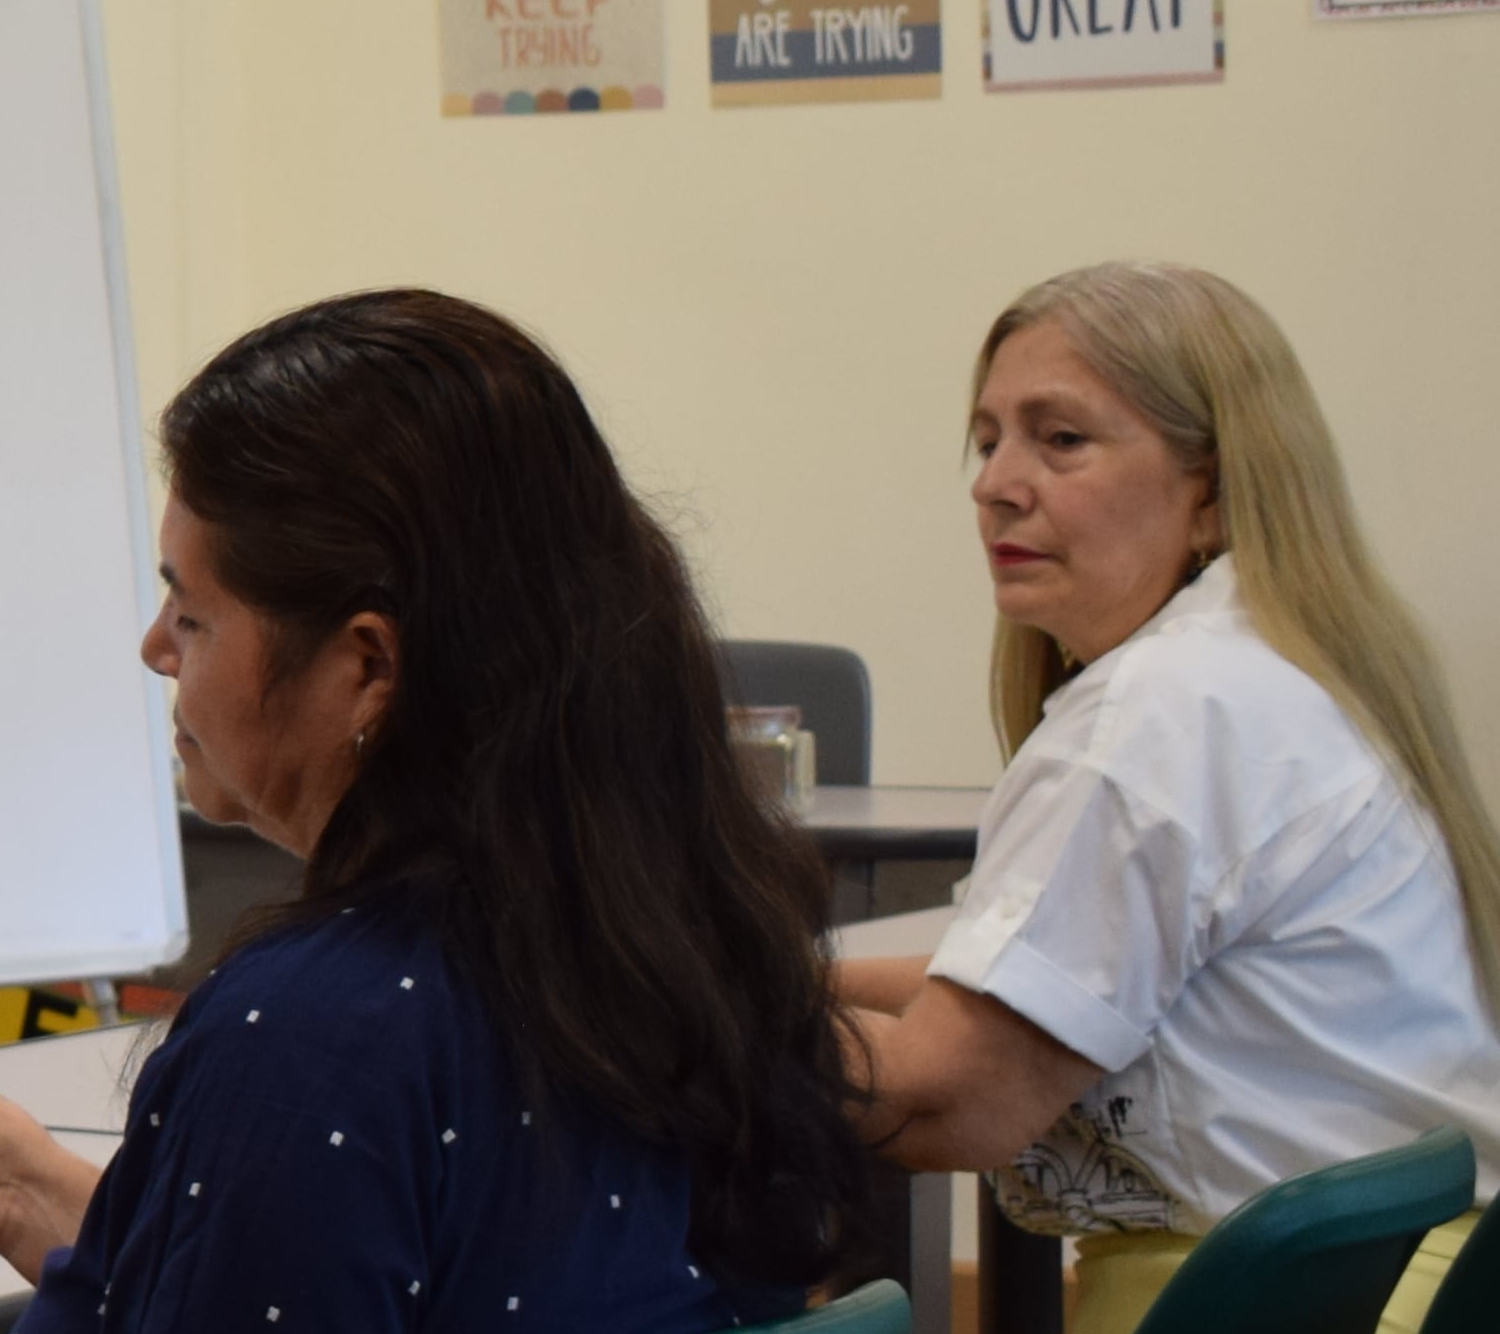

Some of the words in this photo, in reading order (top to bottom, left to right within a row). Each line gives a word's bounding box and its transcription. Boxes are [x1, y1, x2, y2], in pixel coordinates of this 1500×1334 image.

[495, 23, 603, 70] TRYING
[735, 10, 791, 69] ARE
[810, 5, 914, 65] TRYING
